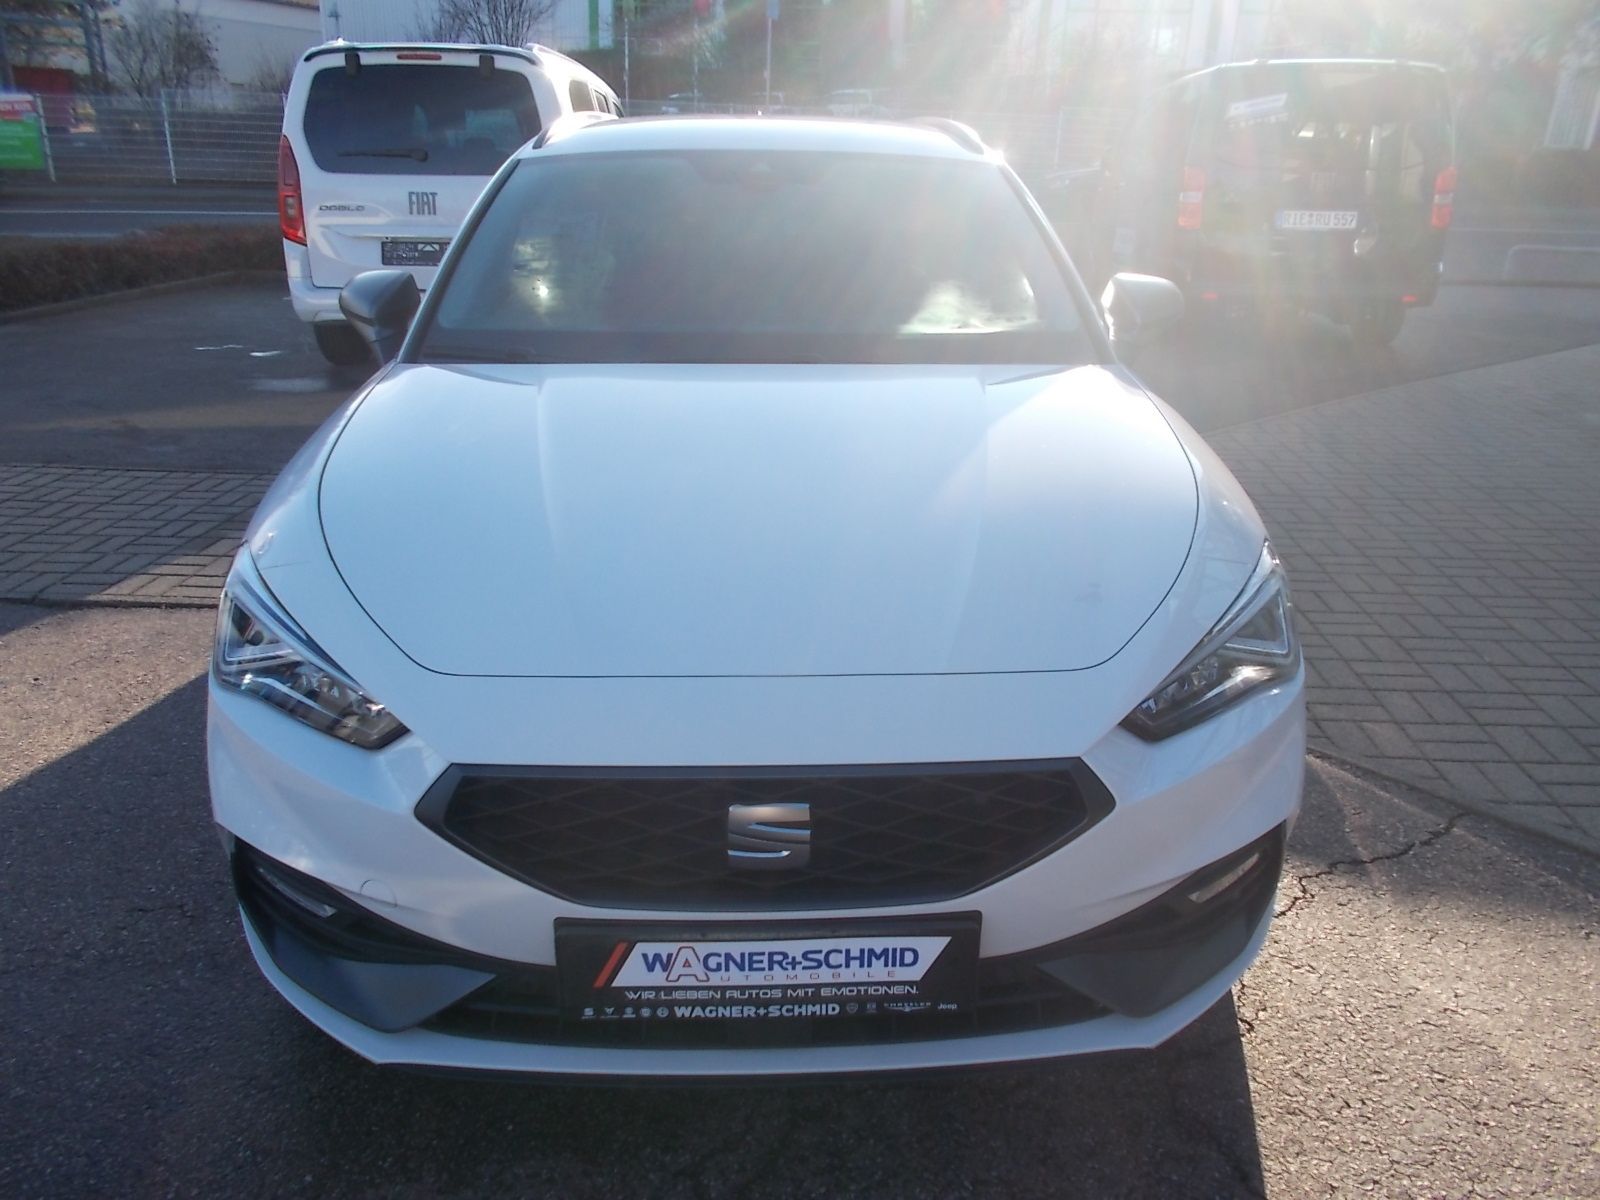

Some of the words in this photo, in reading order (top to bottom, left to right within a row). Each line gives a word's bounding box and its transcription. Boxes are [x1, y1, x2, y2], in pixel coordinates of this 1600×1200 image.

[408, 191, 438, 216] FIAT
[1333, 212, 1357, 226] 557
[641, 946, 919, 983] WAGNER+SCHMID
[624, 990, 656, 1000] WIR
[660, 989, 721, 1000] LIEBEN
[726, 988, 783, 999] AUTOS
[787, 987, 816, 997] MIT
[821, 985, 919, 996] EMOTIONEN.
[675, 1003, 841, 1018] WAGNER+SCHMID
